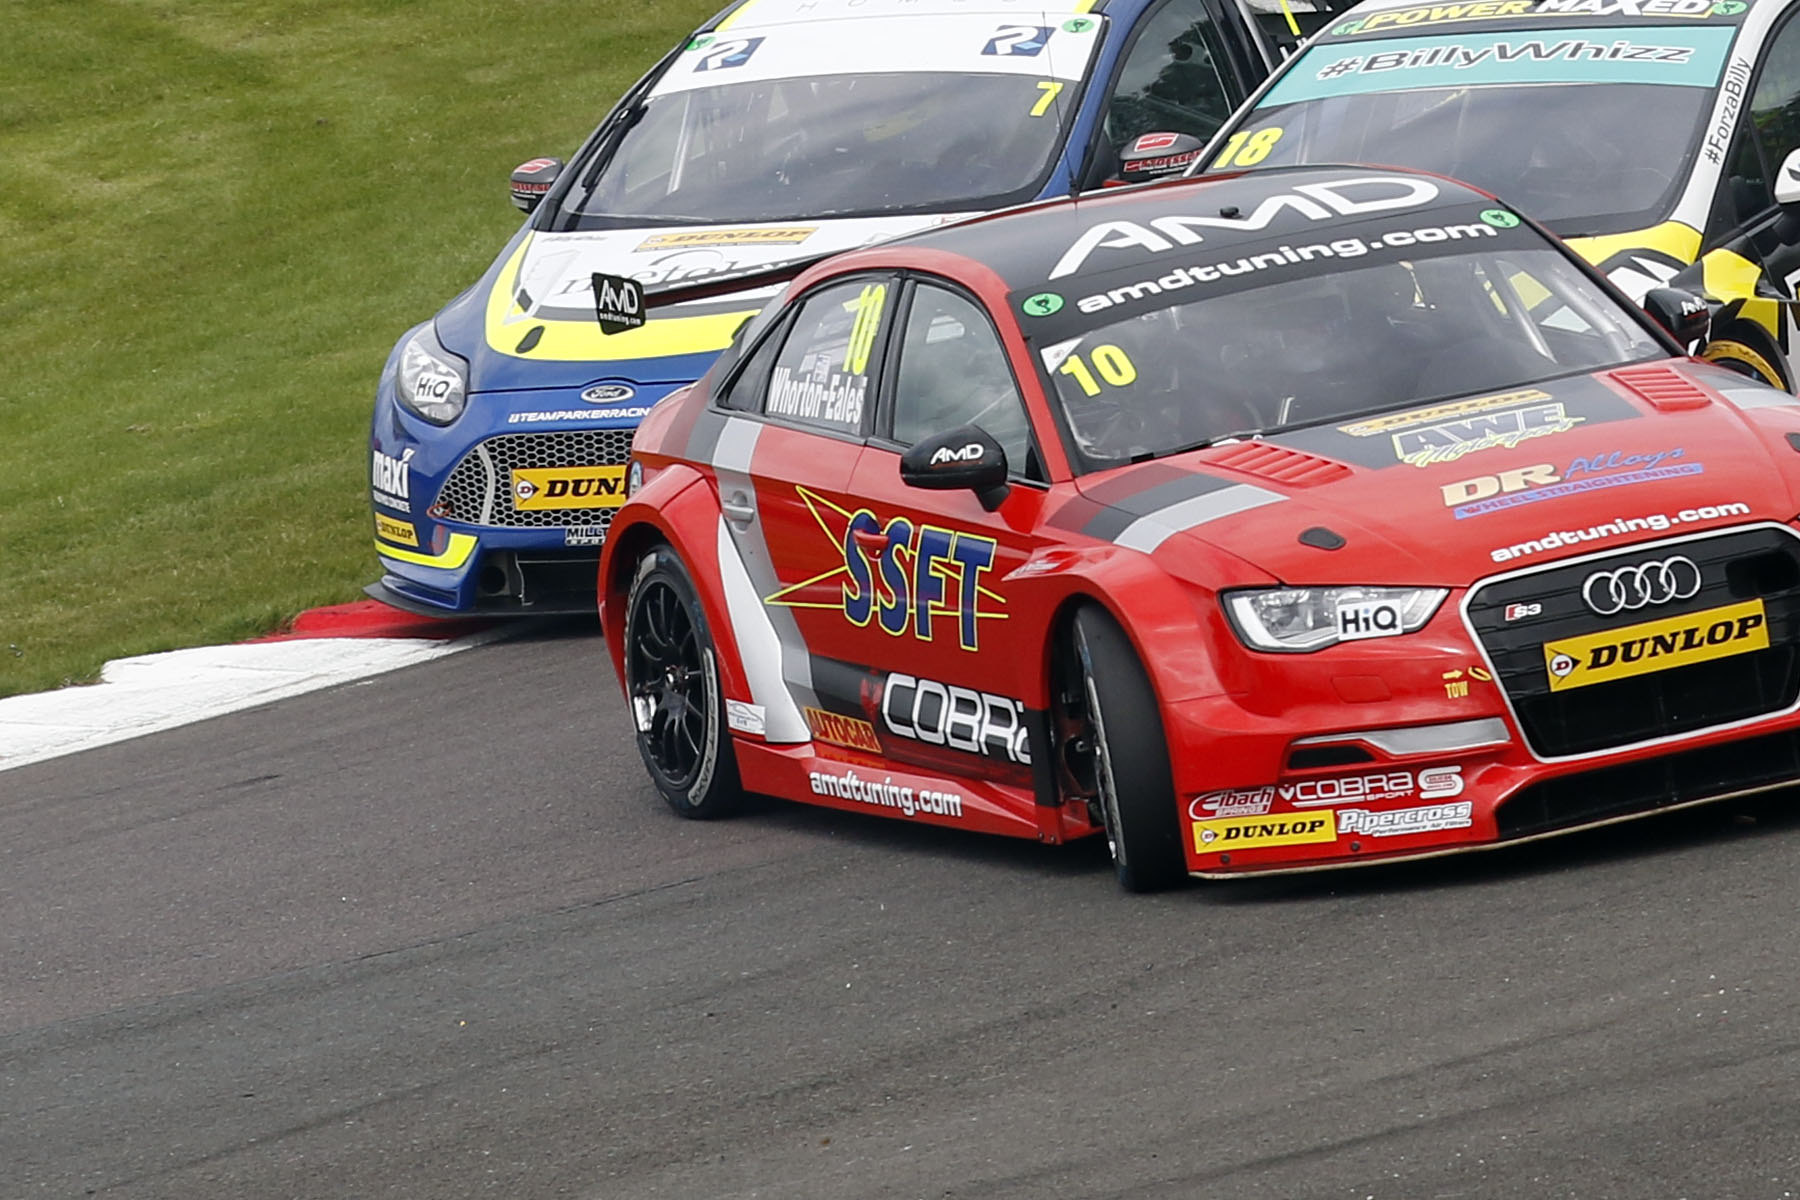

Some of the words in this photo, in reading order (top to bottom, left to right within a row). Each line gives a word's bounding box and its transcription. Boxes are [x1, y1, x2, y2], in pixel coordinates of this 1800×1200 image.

[1367, 1, 1525, 29] POWER
[1317, 40, 1695, 80] #BillyWhizz
[1030, 82, 1064, 116] 7
[1704, 57, 1752, 166] #ForzaBilly
[1213, 127, 1284, 169] 18
[669, 230, 812, 243] DUNLOP
[1048, 177, 1439, 280] AMD
[1077, 221, 1498, 313] amdtuning.com
[842, 284, 887, 376] 10
[417, 376, 449, 400] HiQ
[1060, 345, 1137, 397] 10
[589, 387, 622, 399] Ford
[767, 367, 868, 427] Whorton-Eales
[508, 406, 650, 424] #TEAMPARKERRACIN
[1397, 405, 1565, 458] AWE
[929, 443, 984, 466] AMD
[543, 477, 627, 498] DUN
[1440, 464, 1561, 507] DR
[1563, 448, 1686, 478] Alloys
[1462, 490, 1534, 515] WHEEL
[1536, 464, 1701, 499] STRAIGHTENING
[379, 518, 414, 541] DUNLOP
[1491, 501, 1750, 563] amdtuning.com
[842, 509, 998, 652] SSFT
[1341, 604, 1398, 636] HiQ
[1506, 602, 1542, 620] S3
[1586, 613, 1763, 670] DUNLOP
[1444, 681, 1468, 699] TOW
[809, 710, 881, 752] AUTOCAR
[809, 770, 962, 818] amdtuning.com
[1366, 790, 1414, 800] SPORT
[1223, 819, 1325, 841] DUNLOP
[1337, 802, 1473, 834] Pipercross
